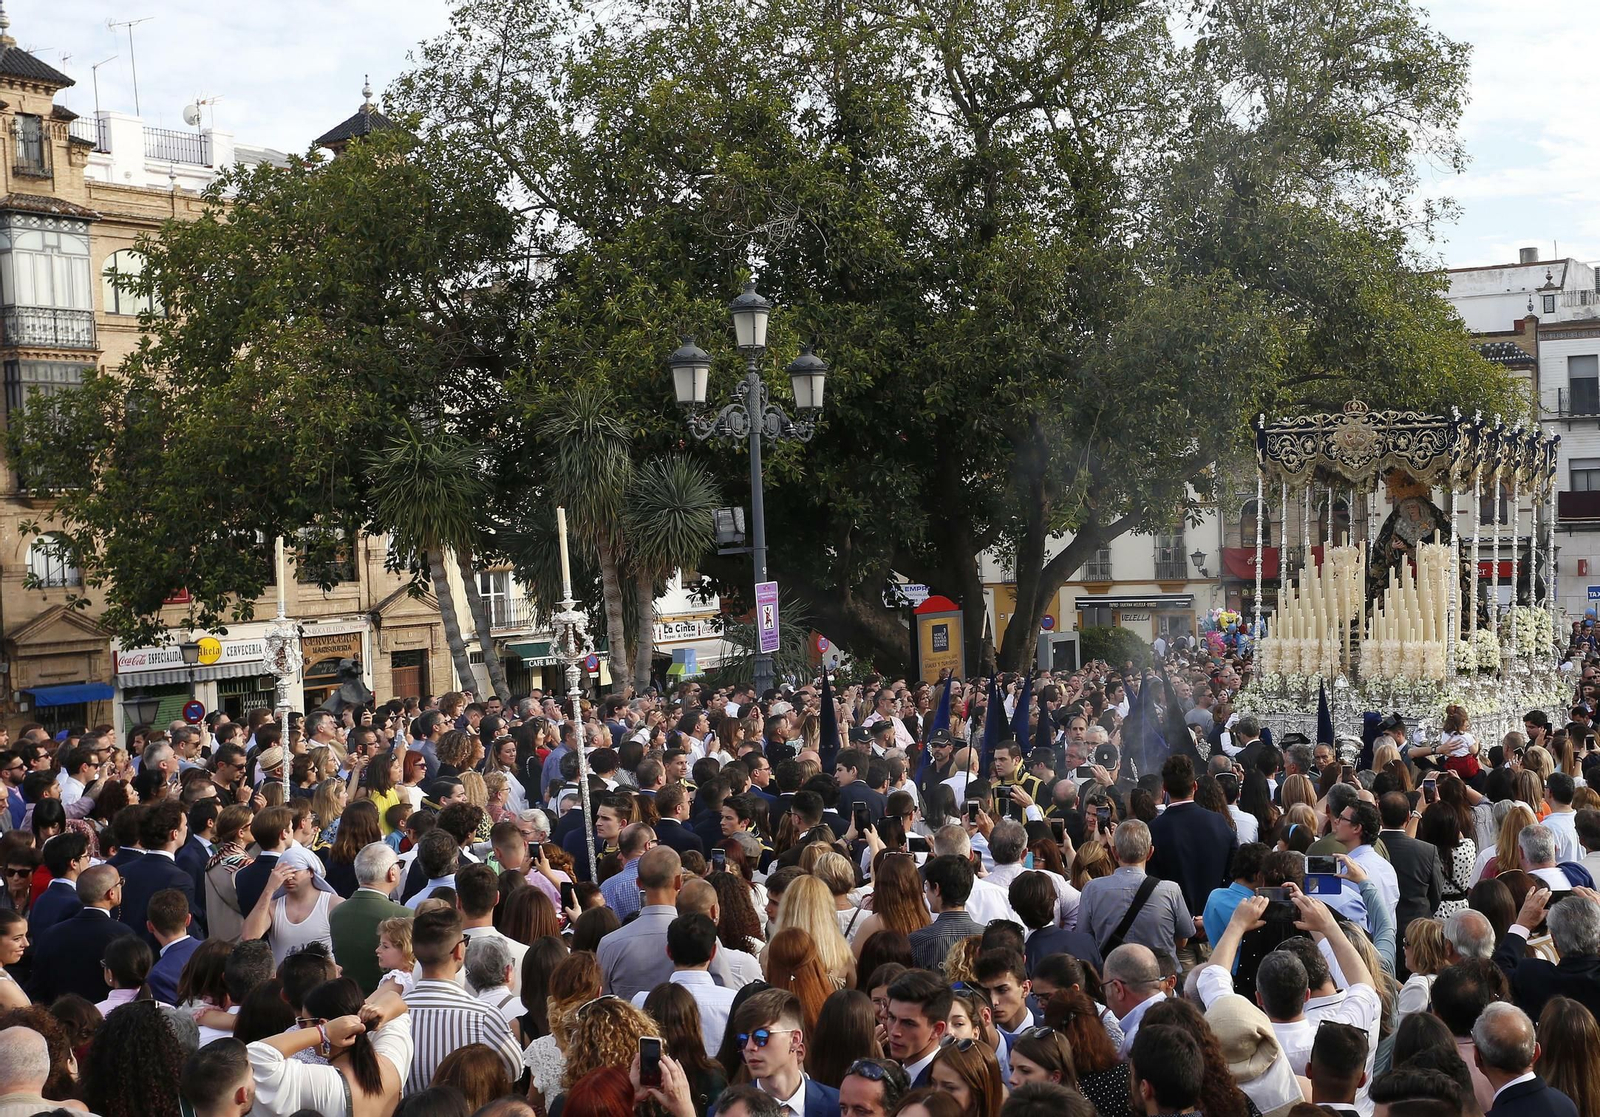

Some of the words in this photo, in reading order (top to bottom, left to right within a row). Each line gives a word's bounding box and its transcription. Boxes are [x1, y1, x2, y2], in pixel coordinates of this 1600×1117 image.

[1121, 614, 1151, 622] VELELLA
[675, 624, 695, 632] Cinta
[226, 643, 263, 657] CERVECERIA
[148, 651, 184, 665] ESPECIALIDA
[545, 658, 558, 666] BAR
